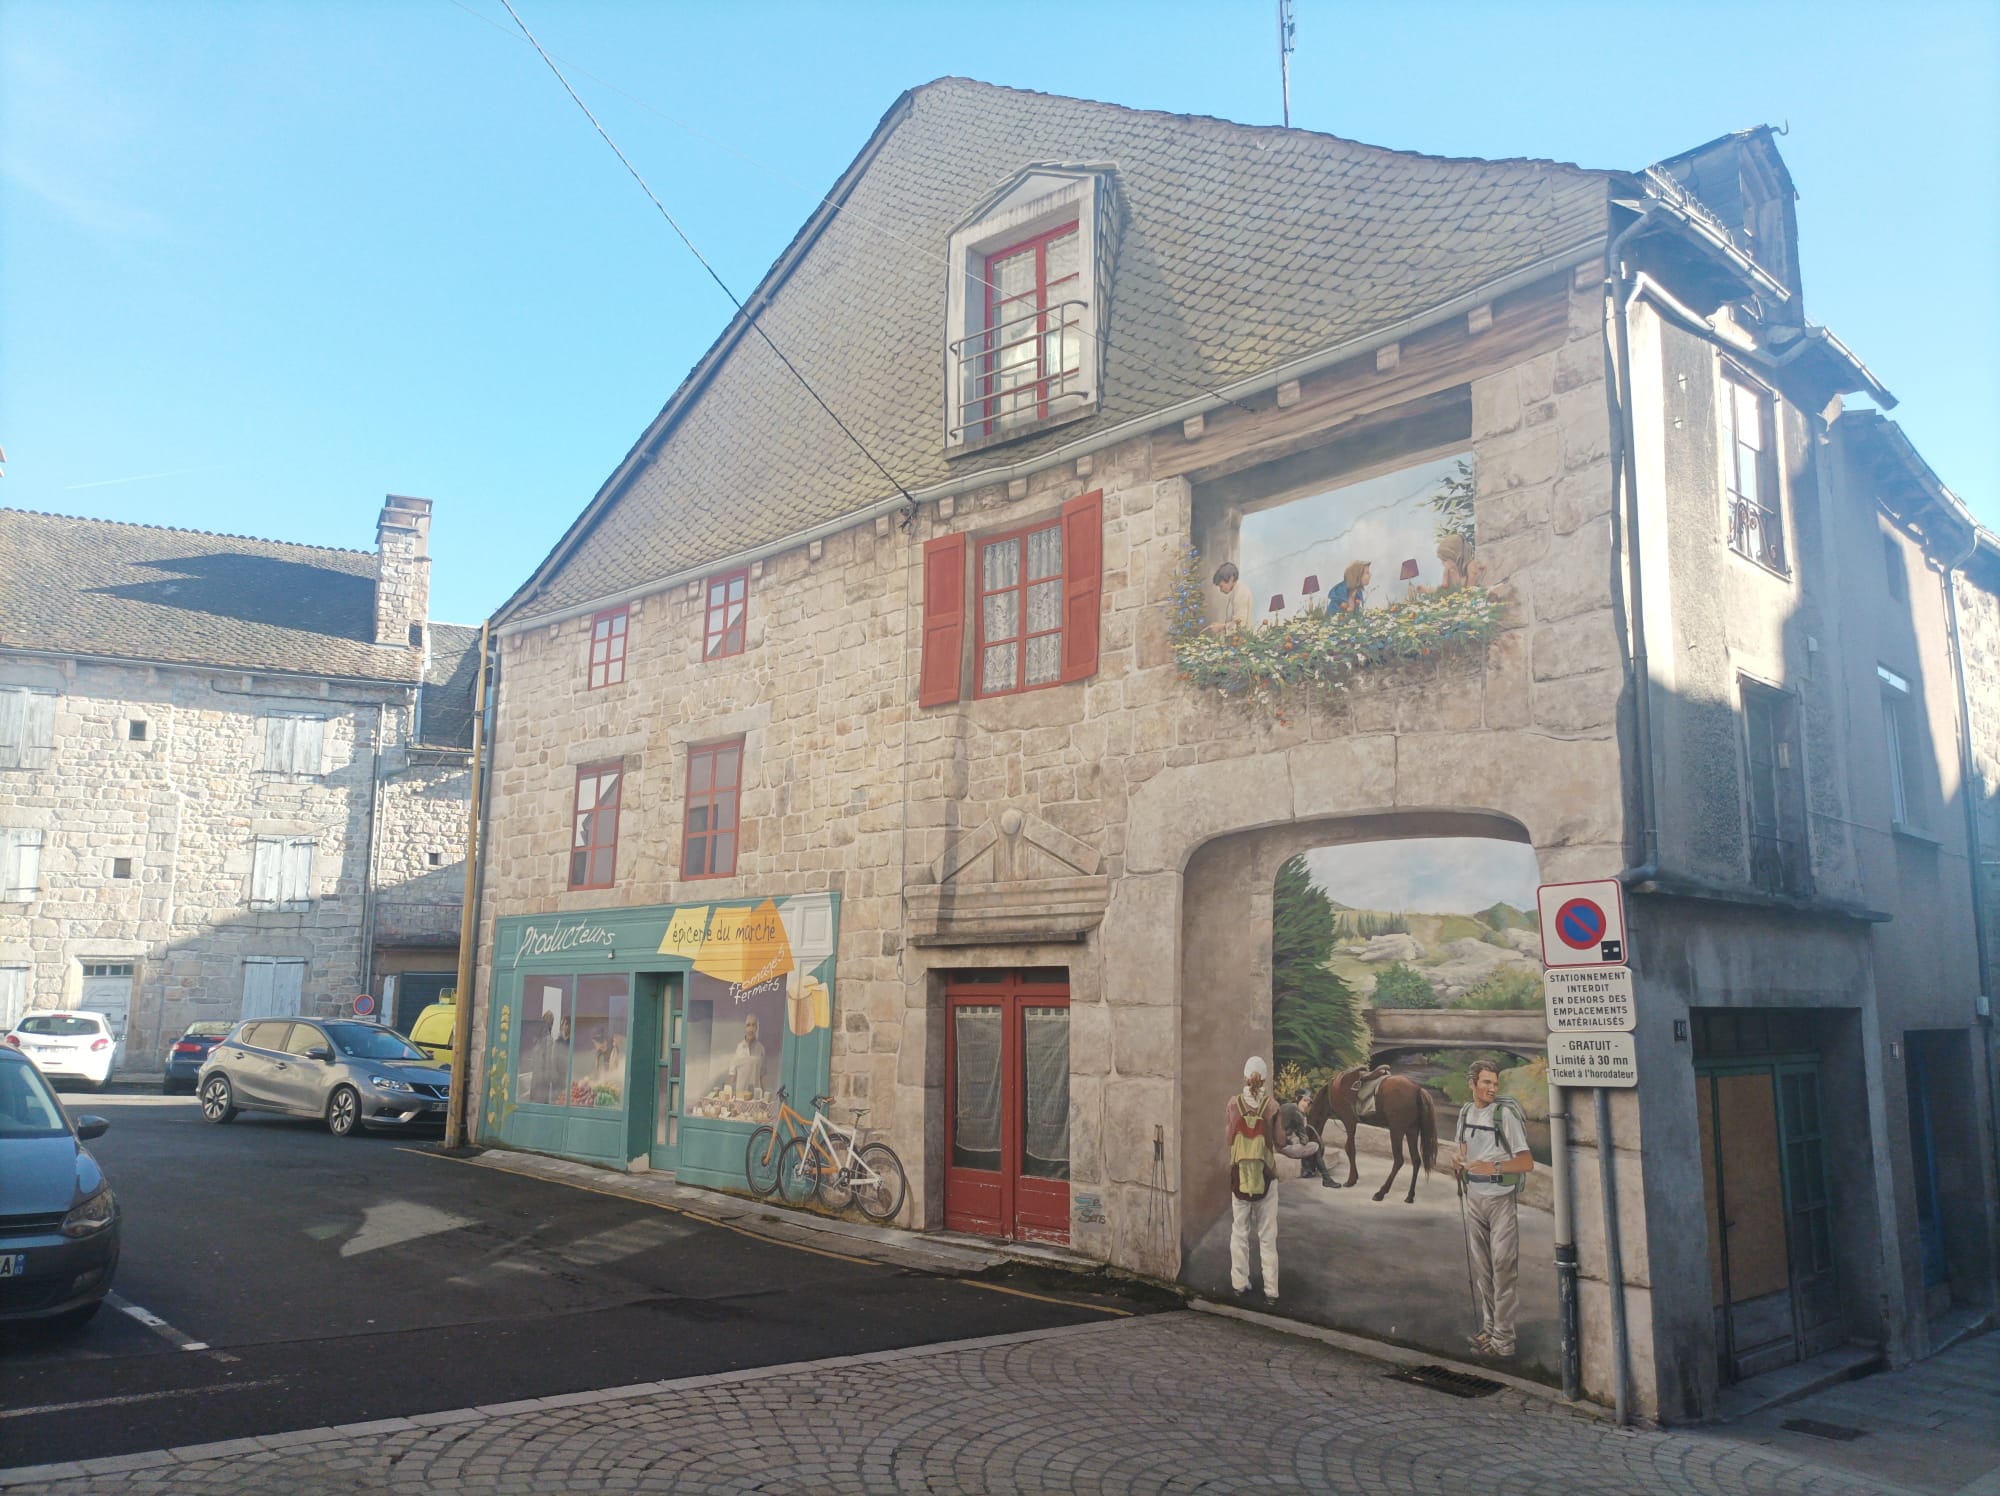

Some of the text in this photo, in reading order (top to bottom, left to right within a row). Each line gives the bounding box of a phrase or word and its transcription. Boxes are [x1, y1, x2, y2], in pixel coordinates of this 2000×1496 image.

[672, 917, 776, 952] épicerie du marché
[513, 918, 616, 968] Producteurs
[728, 944, 785, 996] fromages
[1550, 971, 1626, 983] STATIONNEMENT
[734, 976, 780, 1005] fermiers
[1567, 984, 1609, 993] INTERDIT
[1552, 994, 1627, 1005] EN DEHORS DES
[1553, 1006, 1628, 1016] EMPLACEMENTS
[1558, 1016, 1625, 1027] MATÉRIALISÉS
[1569, 1040, 1611, 1051] GRATUIT
[1555, 1054, 1628, 1065] Limité à 30 mn
[1552, 1068, 1576, 1078] Ticket
[1584, 1068, 1634, 1079] l'horodateur
